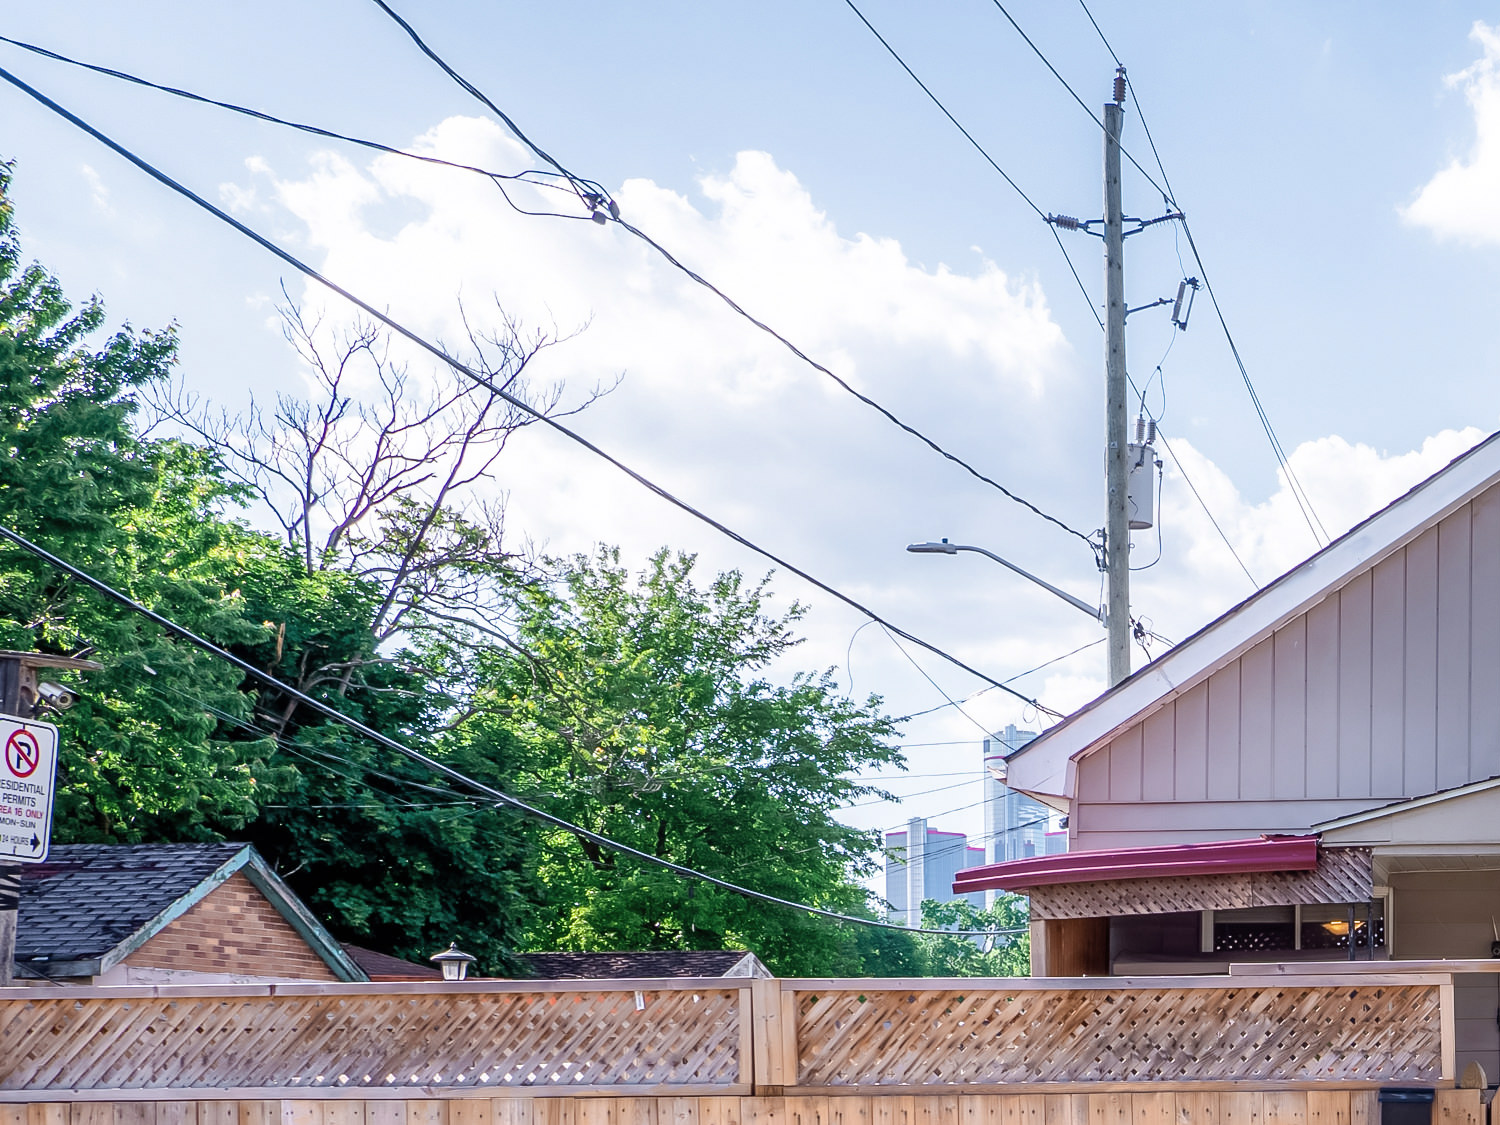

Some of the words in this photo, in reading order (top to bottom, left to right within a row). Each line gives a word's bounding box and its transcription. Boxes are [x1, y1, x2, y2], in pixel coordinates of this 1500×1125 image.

[0, 779, 45, 795] ESIDENTIAL
[2, 792, 36, 807] PERMITS
[15, 807, 22, 817] 16
[26, 809, 43, 819] ONLY
[11, 836, 29, 846] HOURS
